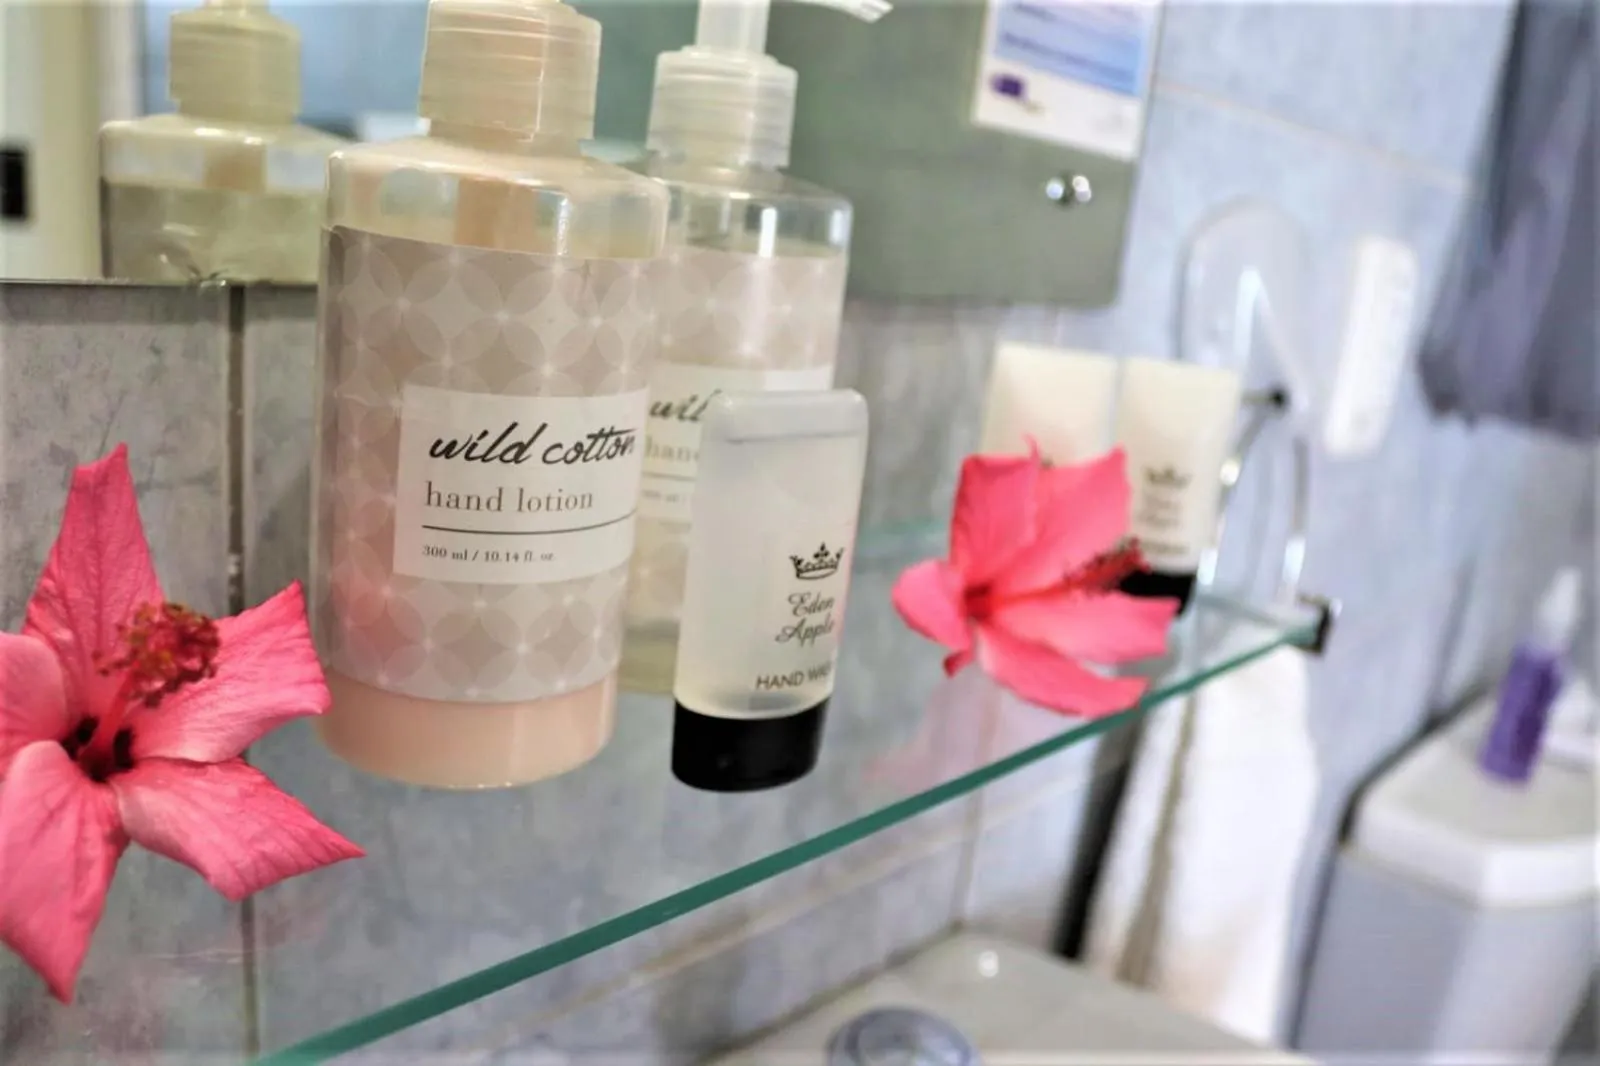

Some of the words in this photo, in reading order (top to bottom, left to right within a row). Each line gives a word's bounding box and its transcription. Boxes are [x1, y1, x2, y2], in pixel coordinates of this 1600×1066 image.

[648, 388, 722, 422] wil
[428, 421, 549, 465] wild
[541, 425, 637, 466] cotton
[645, 436, 699, 463] han
[424, 480, 504, 513] hand
[516, 486, 594, 514] lotion
[422, 544, 448, 559] 300
[451, 548, 469, 562] ml
[484, 550, 520, 563] 10.14
[787, 591, 835, 617] Eden
[755, 670, 805, 691] HAND
